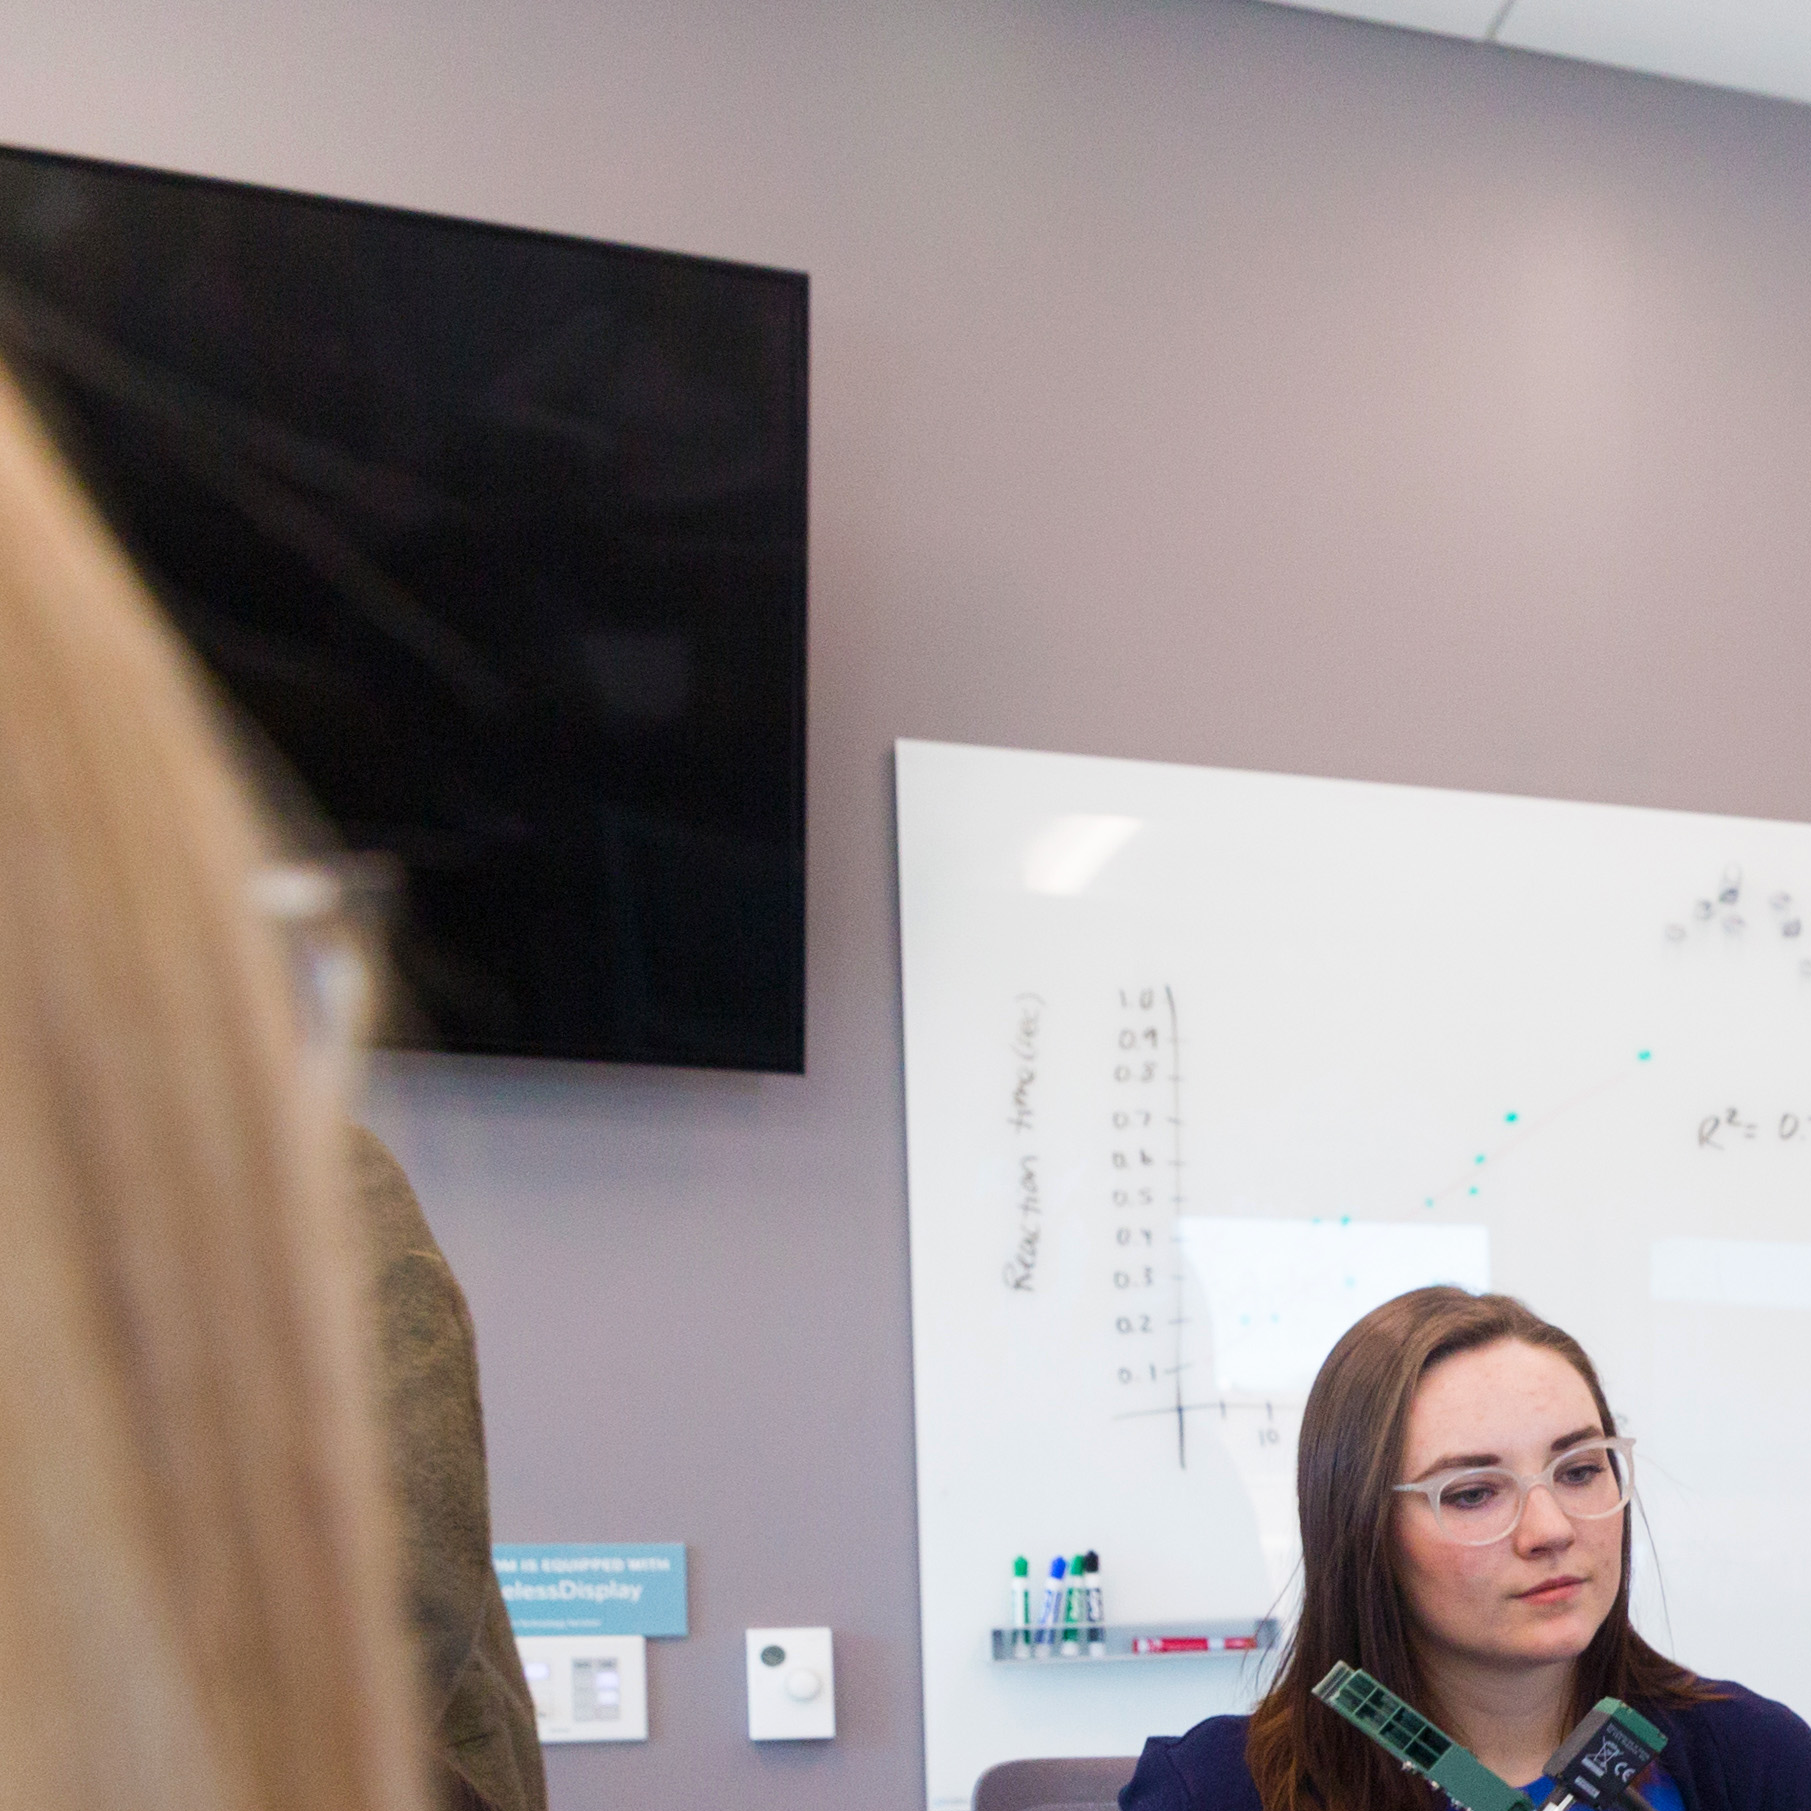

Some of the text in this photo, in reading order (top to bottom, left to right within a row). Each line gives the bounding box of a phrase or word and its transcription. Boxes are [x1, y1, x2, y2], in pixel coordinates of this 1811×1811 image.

[1118, 988, 1154, 1010] 1.0
[1119, 1027, 1158, 1050] 0.9
[1114, 1061, 1156, 1083] 0.8
[1113, 1110, 1151, 1130] 0.7
[1113, 1149, 1152, 1169] 0.6
[1113, 1188, 1153, 1207] 0.5
[1003, 1154, 1041, 1293] Reaction
[1116, 1227, 1152, 1246] 0.4
[1114, 1267, 1153, 1289] 0.3
[1116, 1315, 1152, 1334] 0.2
[1118, 1362, 1157, 1384] 0.1
[520, 1559, 538, 1573] IS
[541, 1558, 625, 1573] EQUIPPED
[628, 1557, 671, 1572] WITH
